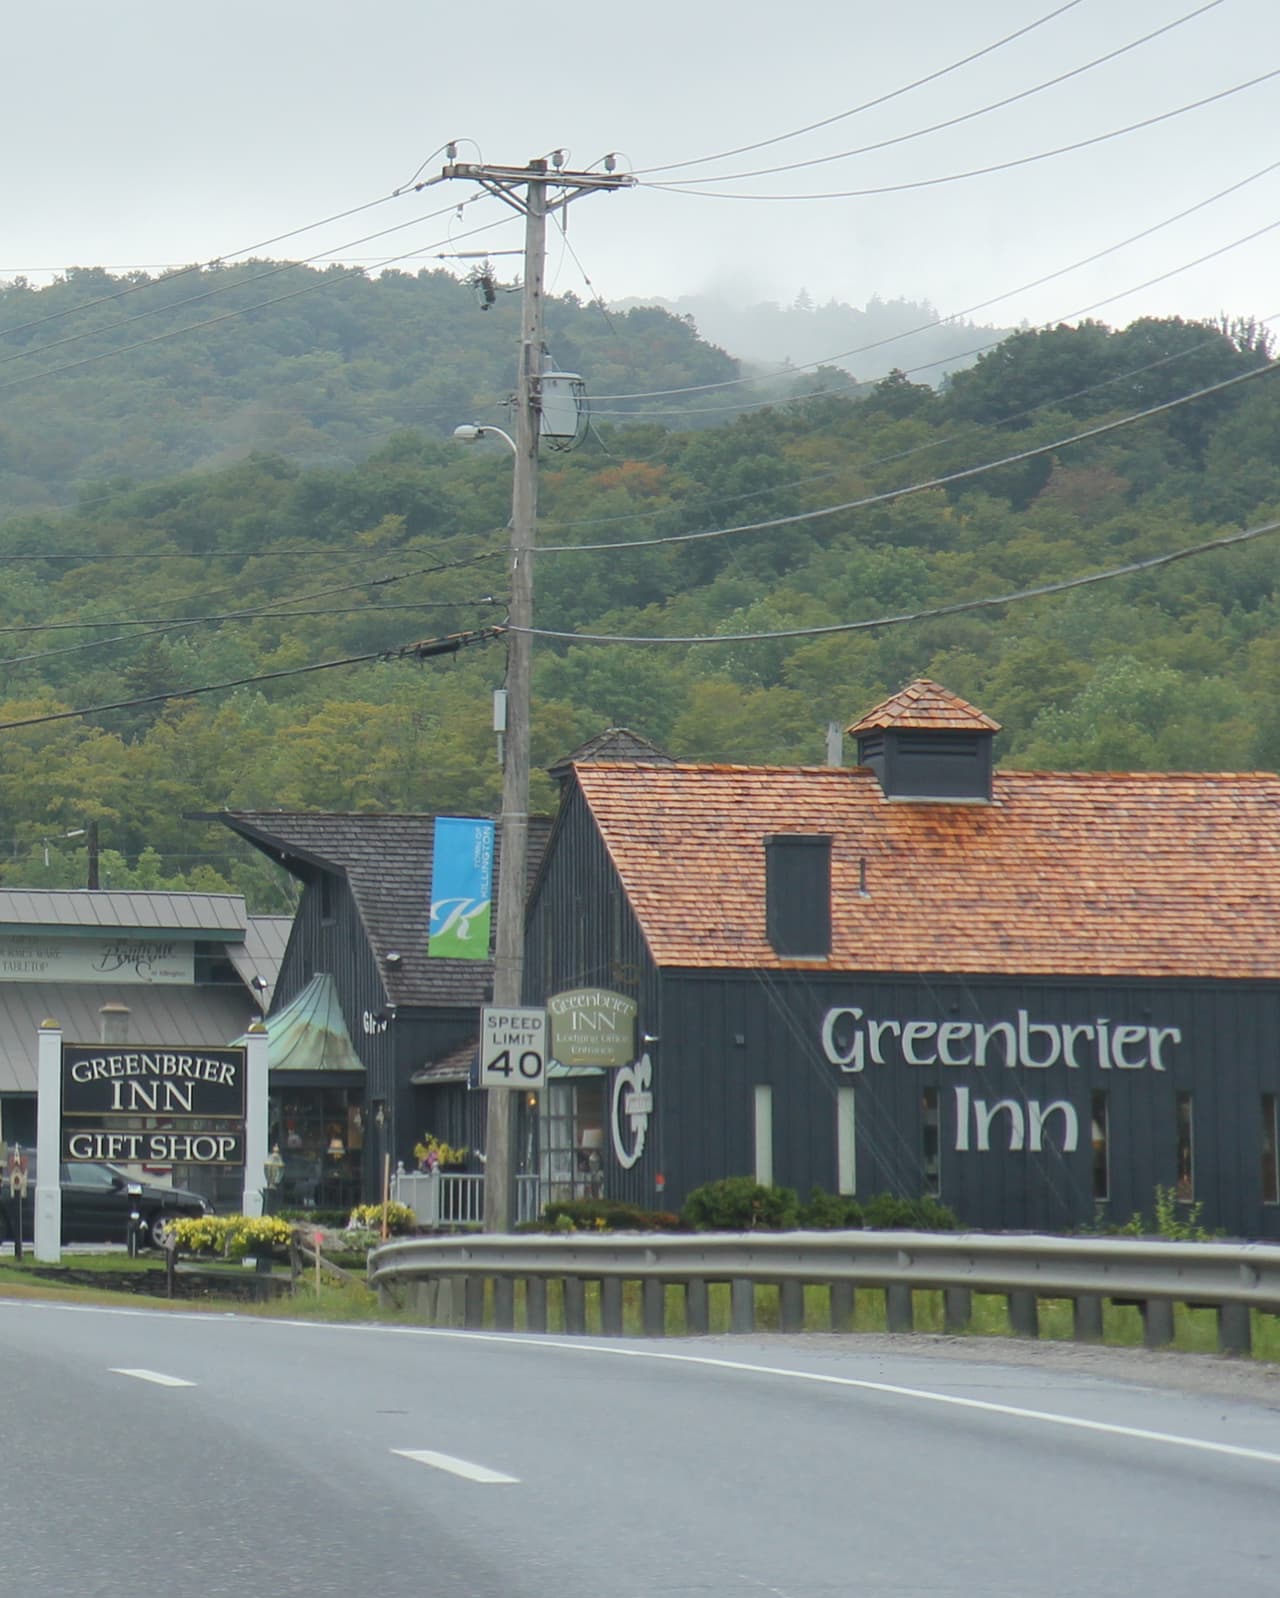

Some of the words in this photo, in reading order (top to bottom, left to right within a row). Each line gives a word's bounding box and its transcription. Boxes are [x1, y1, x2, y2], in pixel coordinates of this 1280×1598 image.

[481, 826, 492, 898] KILLINGTON
[488, 1016, 542, 1030] SPEED
[572, 1011, 616, 1031] INN
[492, 1033, 536, 1046] LIMIT
[822, 1007, 1182, 1072] Greenbrier
[71, 1054, 236, 1086] GREENBRIER
[487, 1050, 542, 1079] 40
[111, 1080, 196, 1112] INN
[955, 1086, 1079, 1152] Inn
[69, 1134, 143, 1159] GIFT
[149, 1136, 236, 1161] SHOP
